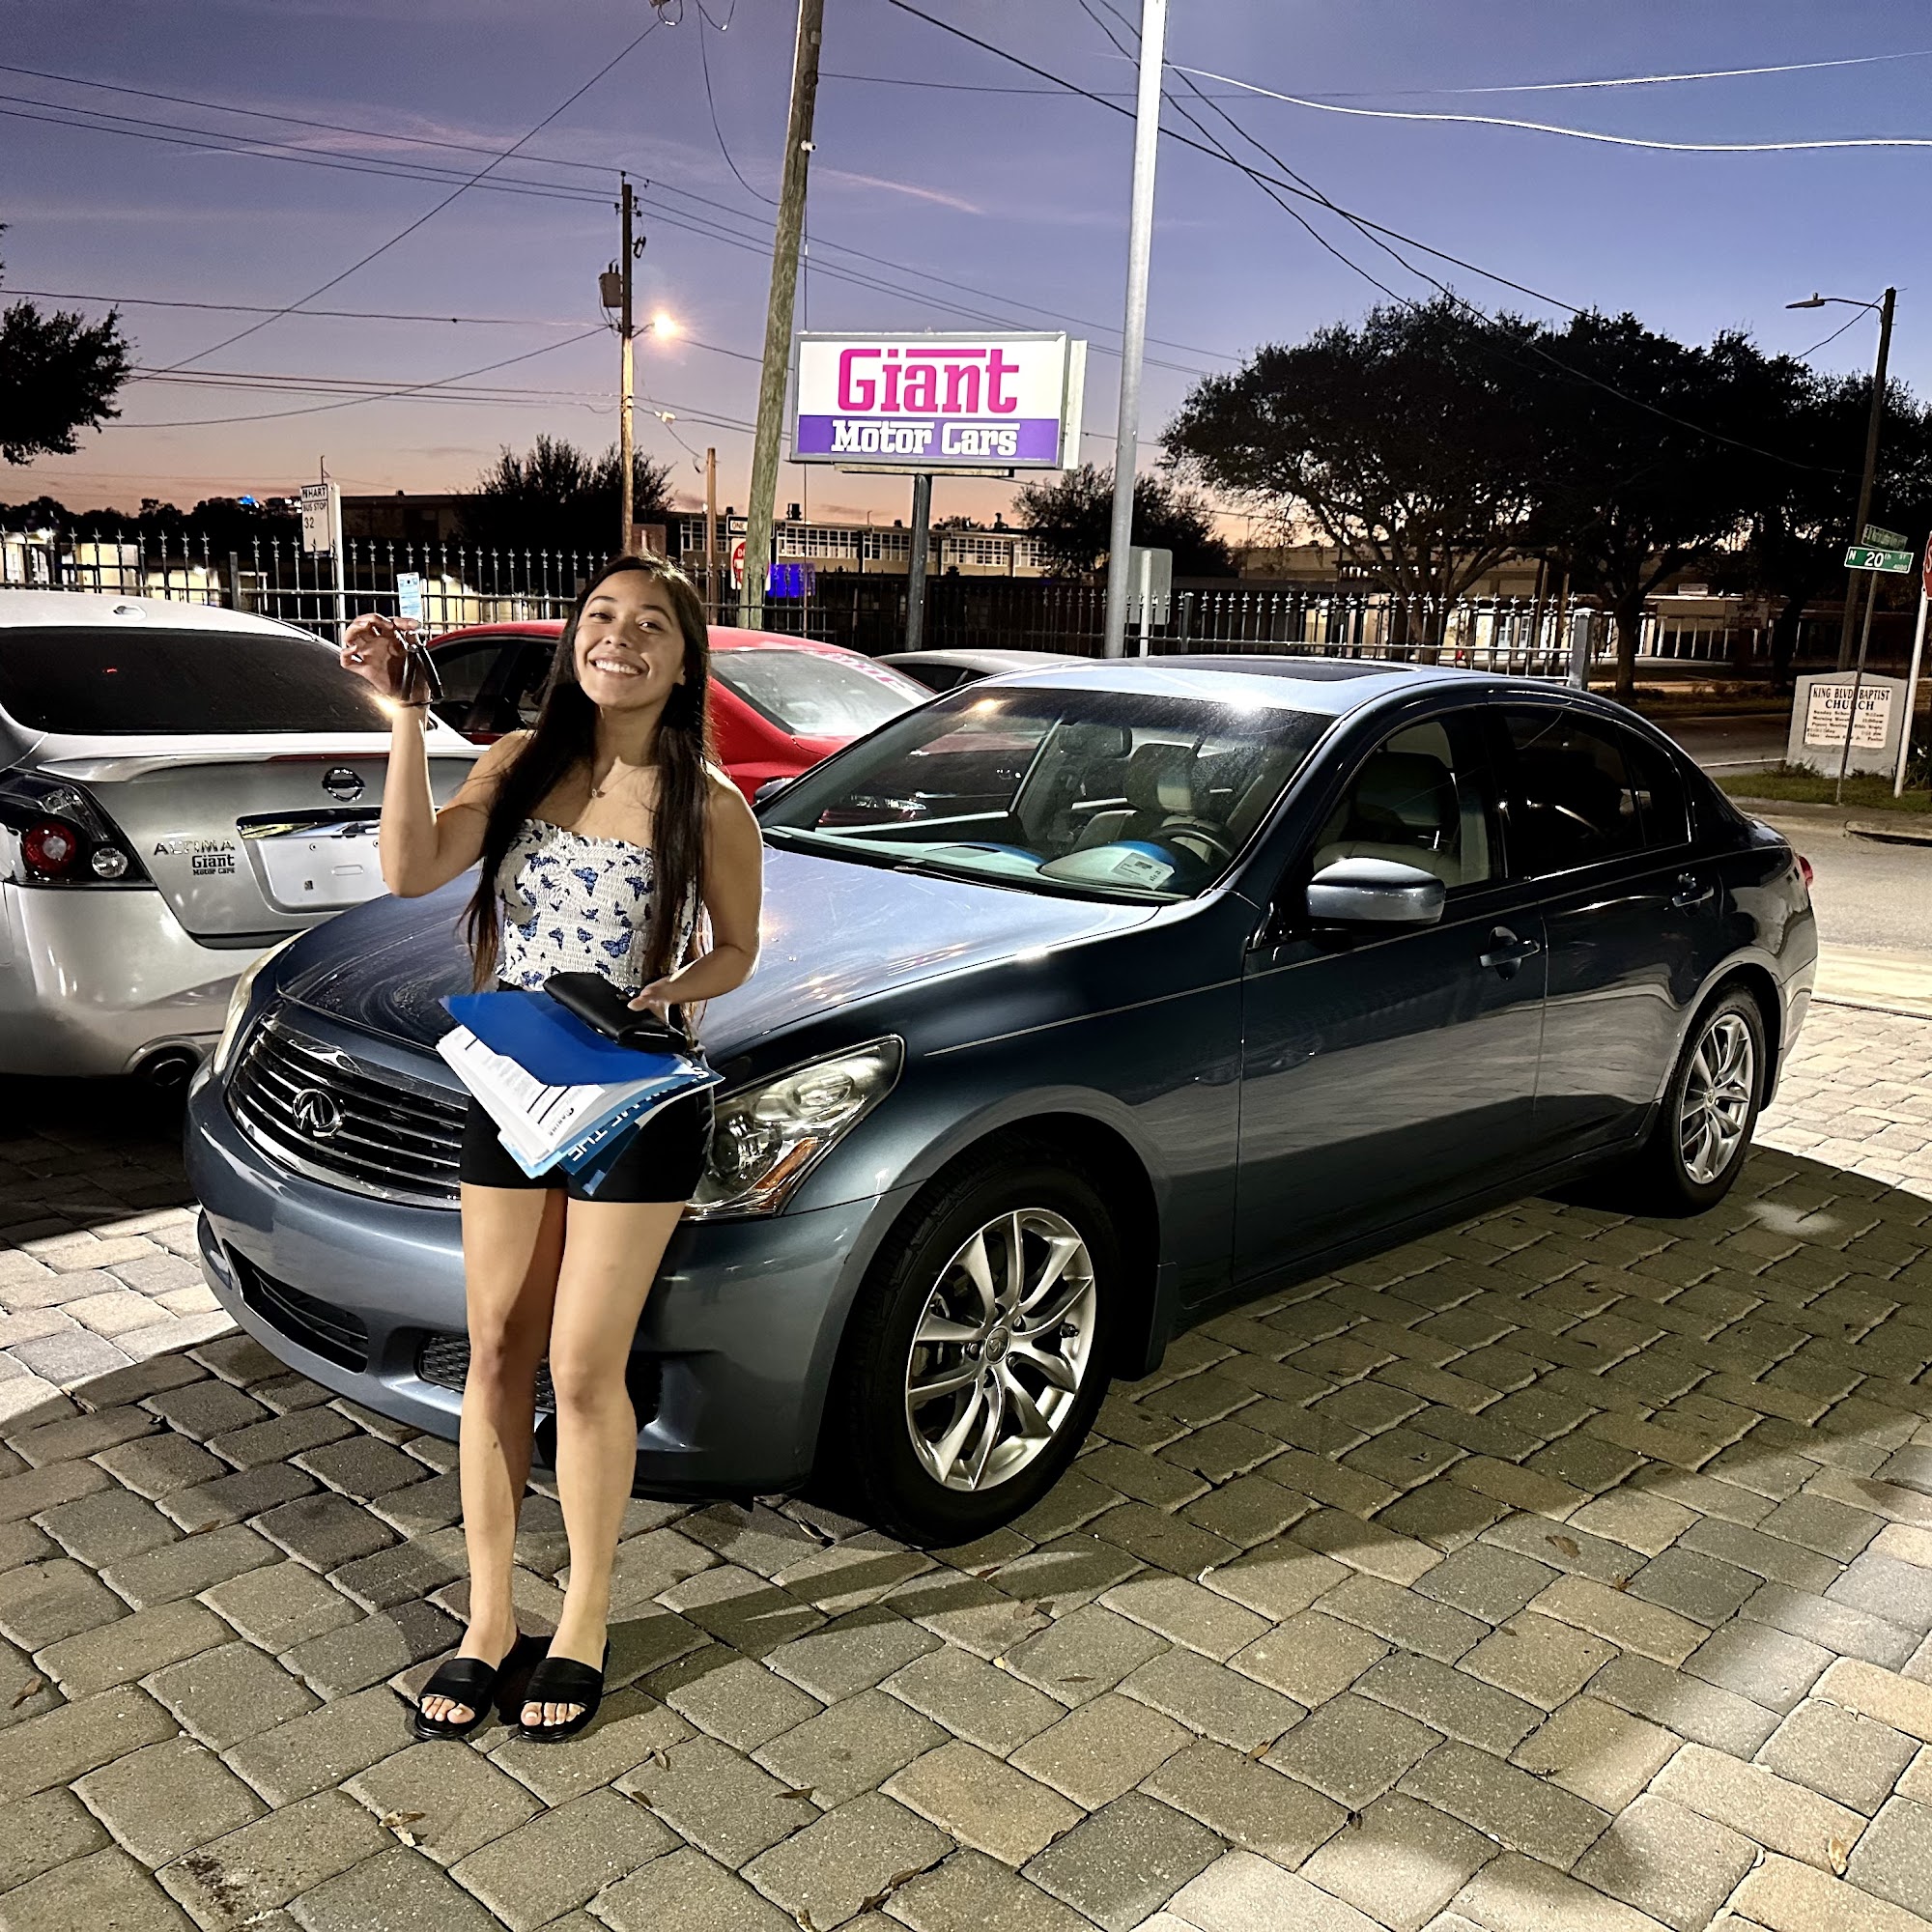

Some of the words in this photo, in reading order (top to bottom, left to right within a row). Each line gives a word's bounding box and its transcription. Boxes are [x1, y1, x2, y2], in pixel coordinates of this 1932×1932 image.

[838, 349, 1019, 413] Giant
[831, 419, 934, 455] Motor
[941, 422, 1020, 456] Cars
[303, 503, 312, 512] BUS
[314, 502, 326, 511] STOP
[304, 517, 314, 528] 32
[731, 522, 745, 530] ONE
[1849, 550, 1857, 560] N
[1813, 687, 1832, 698] KING
[1834, 688, 1854, 699] BLVD
[1859, 689, 1890, 701] BAPTIST
[1825, 698, 1875, 711] CHUCH
[154, 838, 236, 855] ALTIMA
[192, 854, 235, 868] Giant
